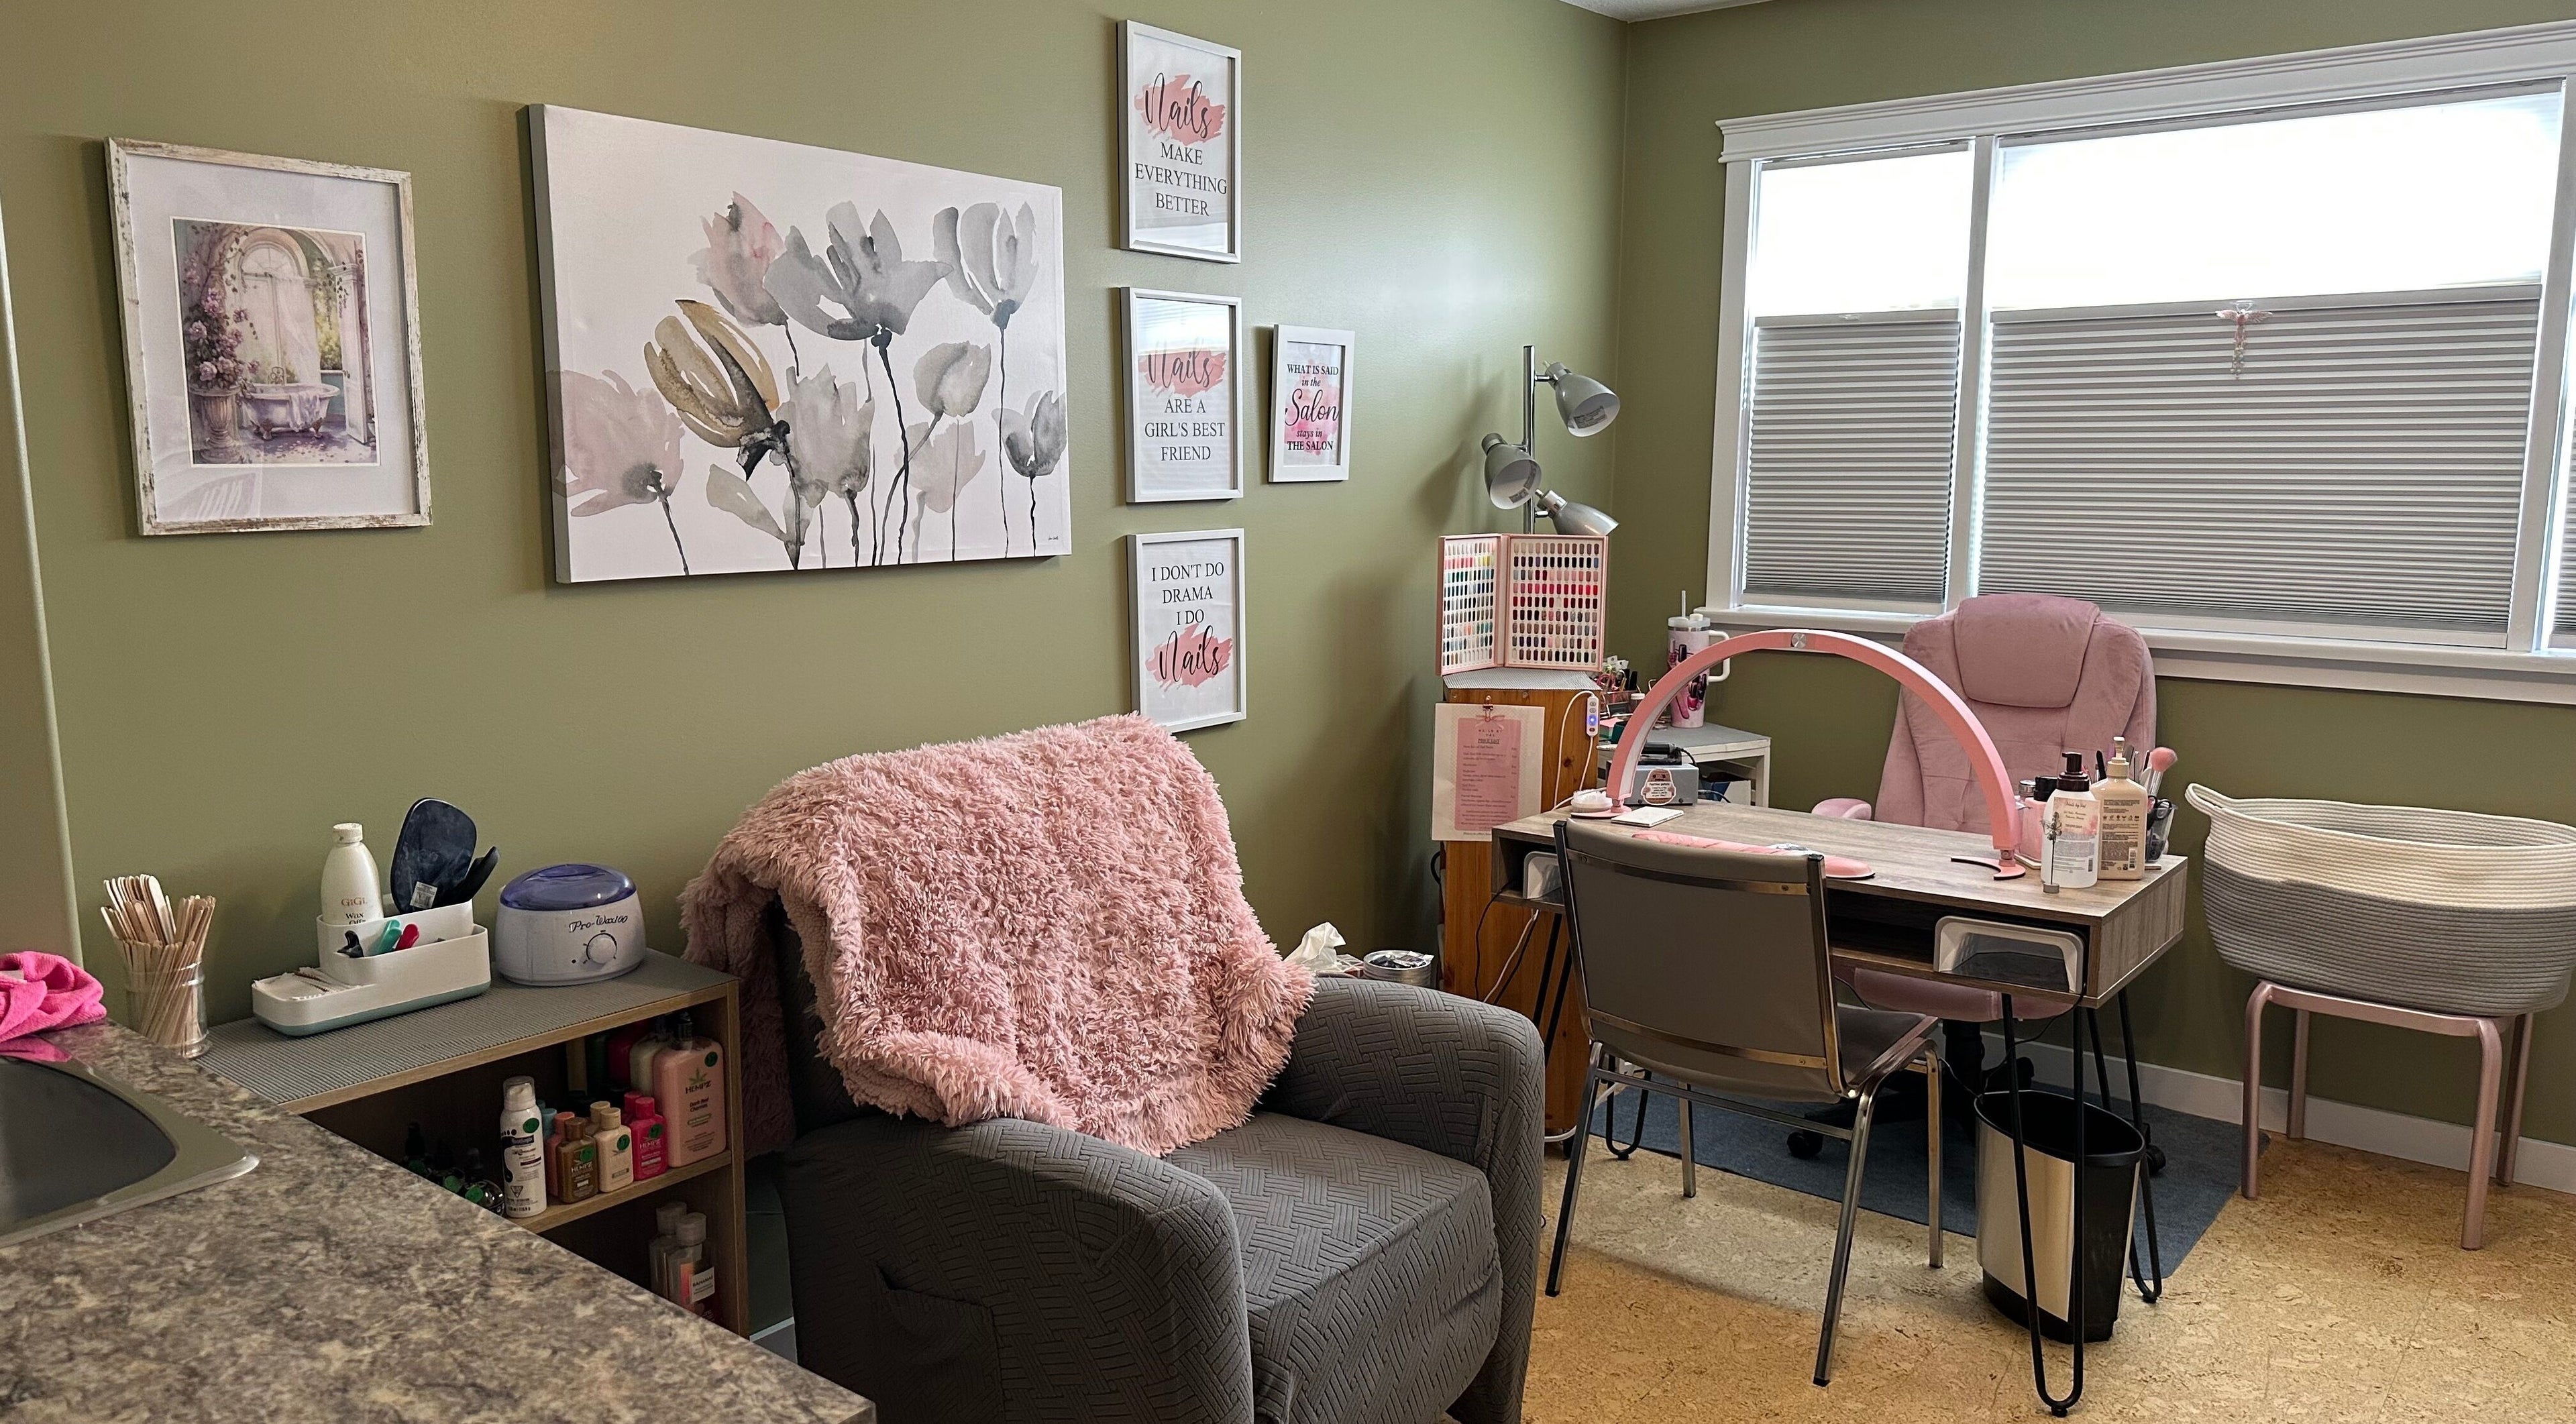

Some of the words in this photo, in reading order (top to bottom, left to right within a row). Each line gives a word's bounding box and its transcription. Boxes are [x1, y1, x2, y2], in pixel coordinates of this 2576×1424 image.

[1144, 72, 1212, 139] Nails
[1161, 142, 1203, 166] MAKE
[1134, 163, 1227, 195] EVERYTHING
[1155, 193, 1210, 217] BETTER
[1148, 337, 1213, 388] Nails
[1287, 364, 1311, 374] WHAT
[1312, 366, 1320, 374] IS
[1321, 366, 1339, 376] SAID
[1302, 376, 1309, 386] in
[1310, 377, 1321, 387] the
[1164, 398, 1192, 413] ARE
[1196, 399, 1206, 413] A
[1285, 388, 1340, 427] Salon
[1144, 422, 1189, 437] GIRL'S
[1192, 422, 1226, 437] BEST
[1296, 430, 1314, 440] stays
[1315, 428, 1322, 438] in
[1161, 446, 1212, 461] FRIEND
[1287, 441, 1304, 451] THE
[1305, 441, 1334, 451] SALON
[1151, 567, 1157, 582] I
[1161, 563, 1201, 581] DON'T
[1205, 561, 1224, 578] DO
[1163, 586, 1214, 604] DRAMA
[1176, 611, 1181, 625] I
[1185, 609, 1205, 624] DO
[1159, 625, 1223, 683] Nails
[341, 897, 366, 907] GiGi
[569, 914, 628, 933] Pro-Wax100
